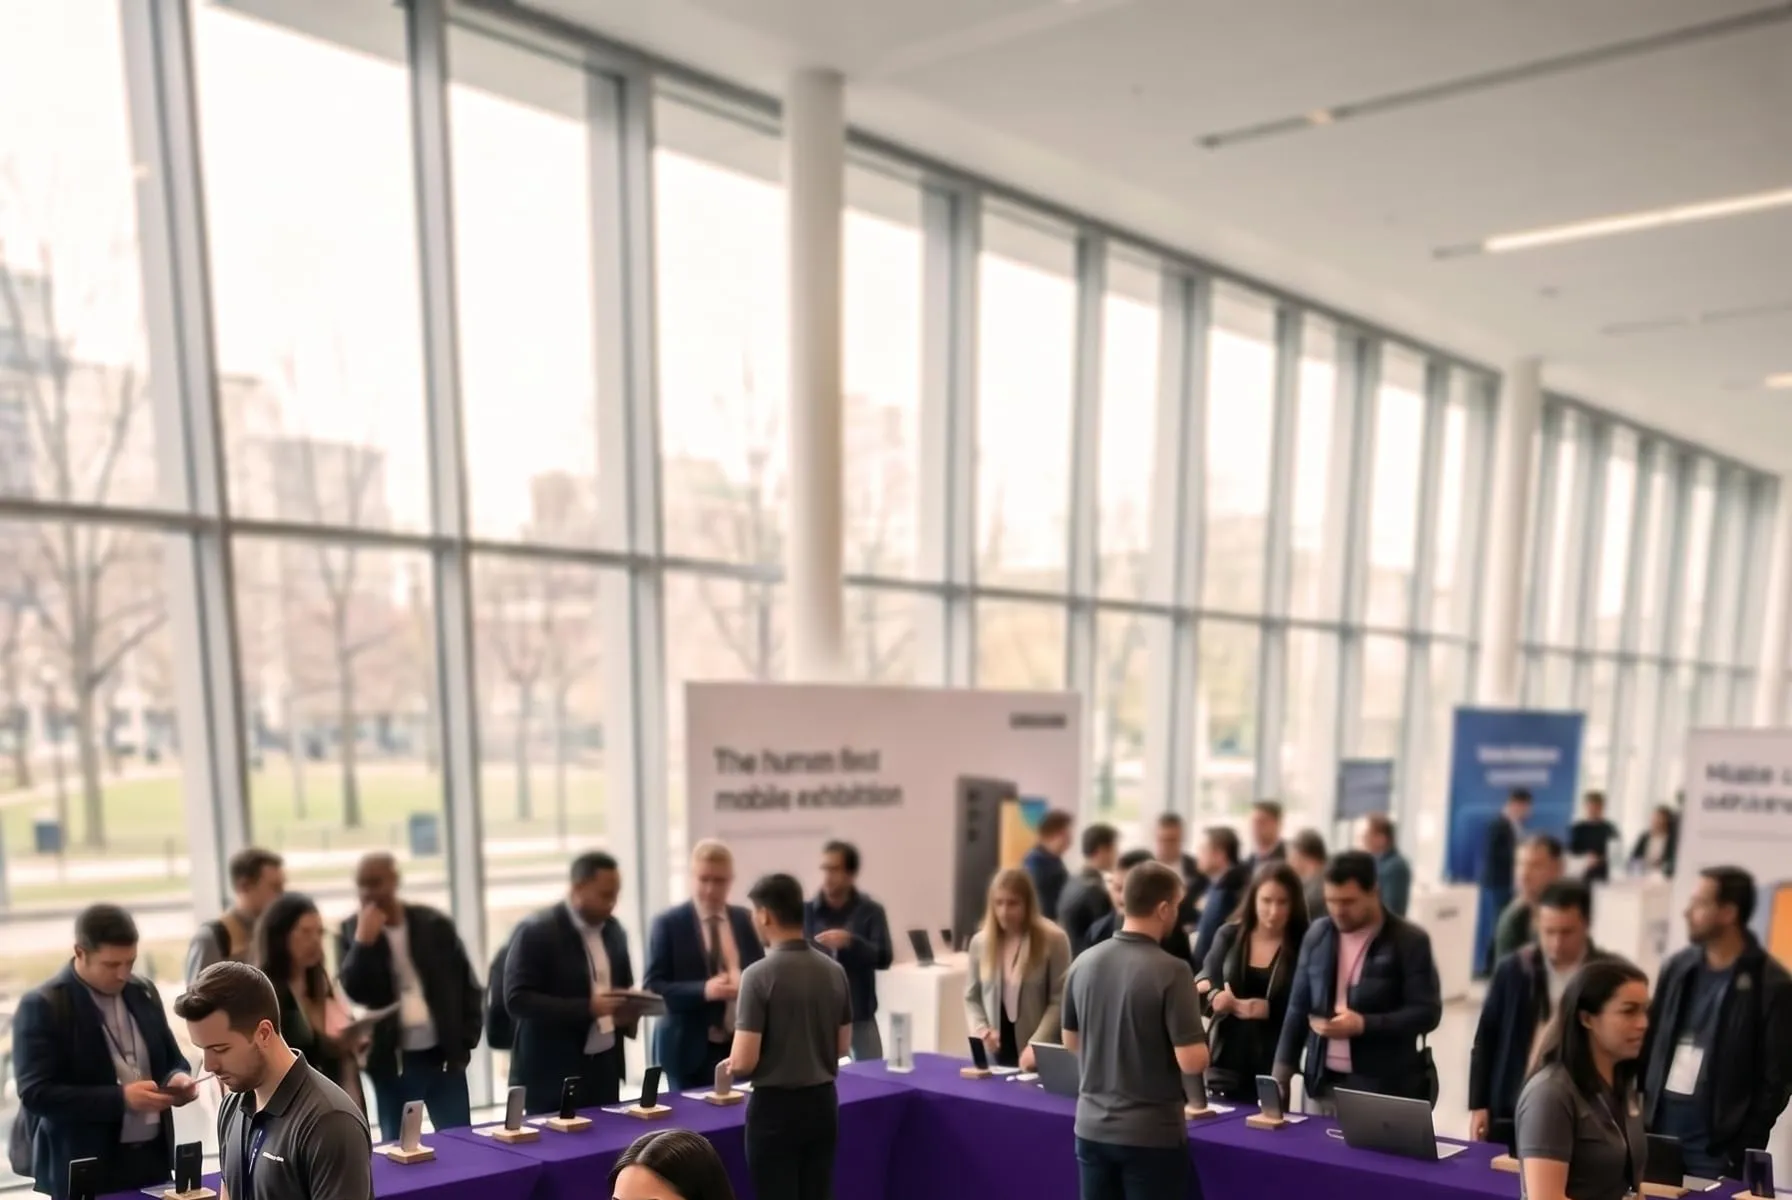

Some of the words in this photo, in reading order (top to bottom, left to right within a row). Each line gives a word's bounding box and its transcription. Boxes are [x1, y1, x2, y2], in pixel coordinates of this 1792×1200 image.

[714, 747, 757, 773] The
[715, 785, 790, 810] mobile
[797, 782, 903, 807] exhibition
